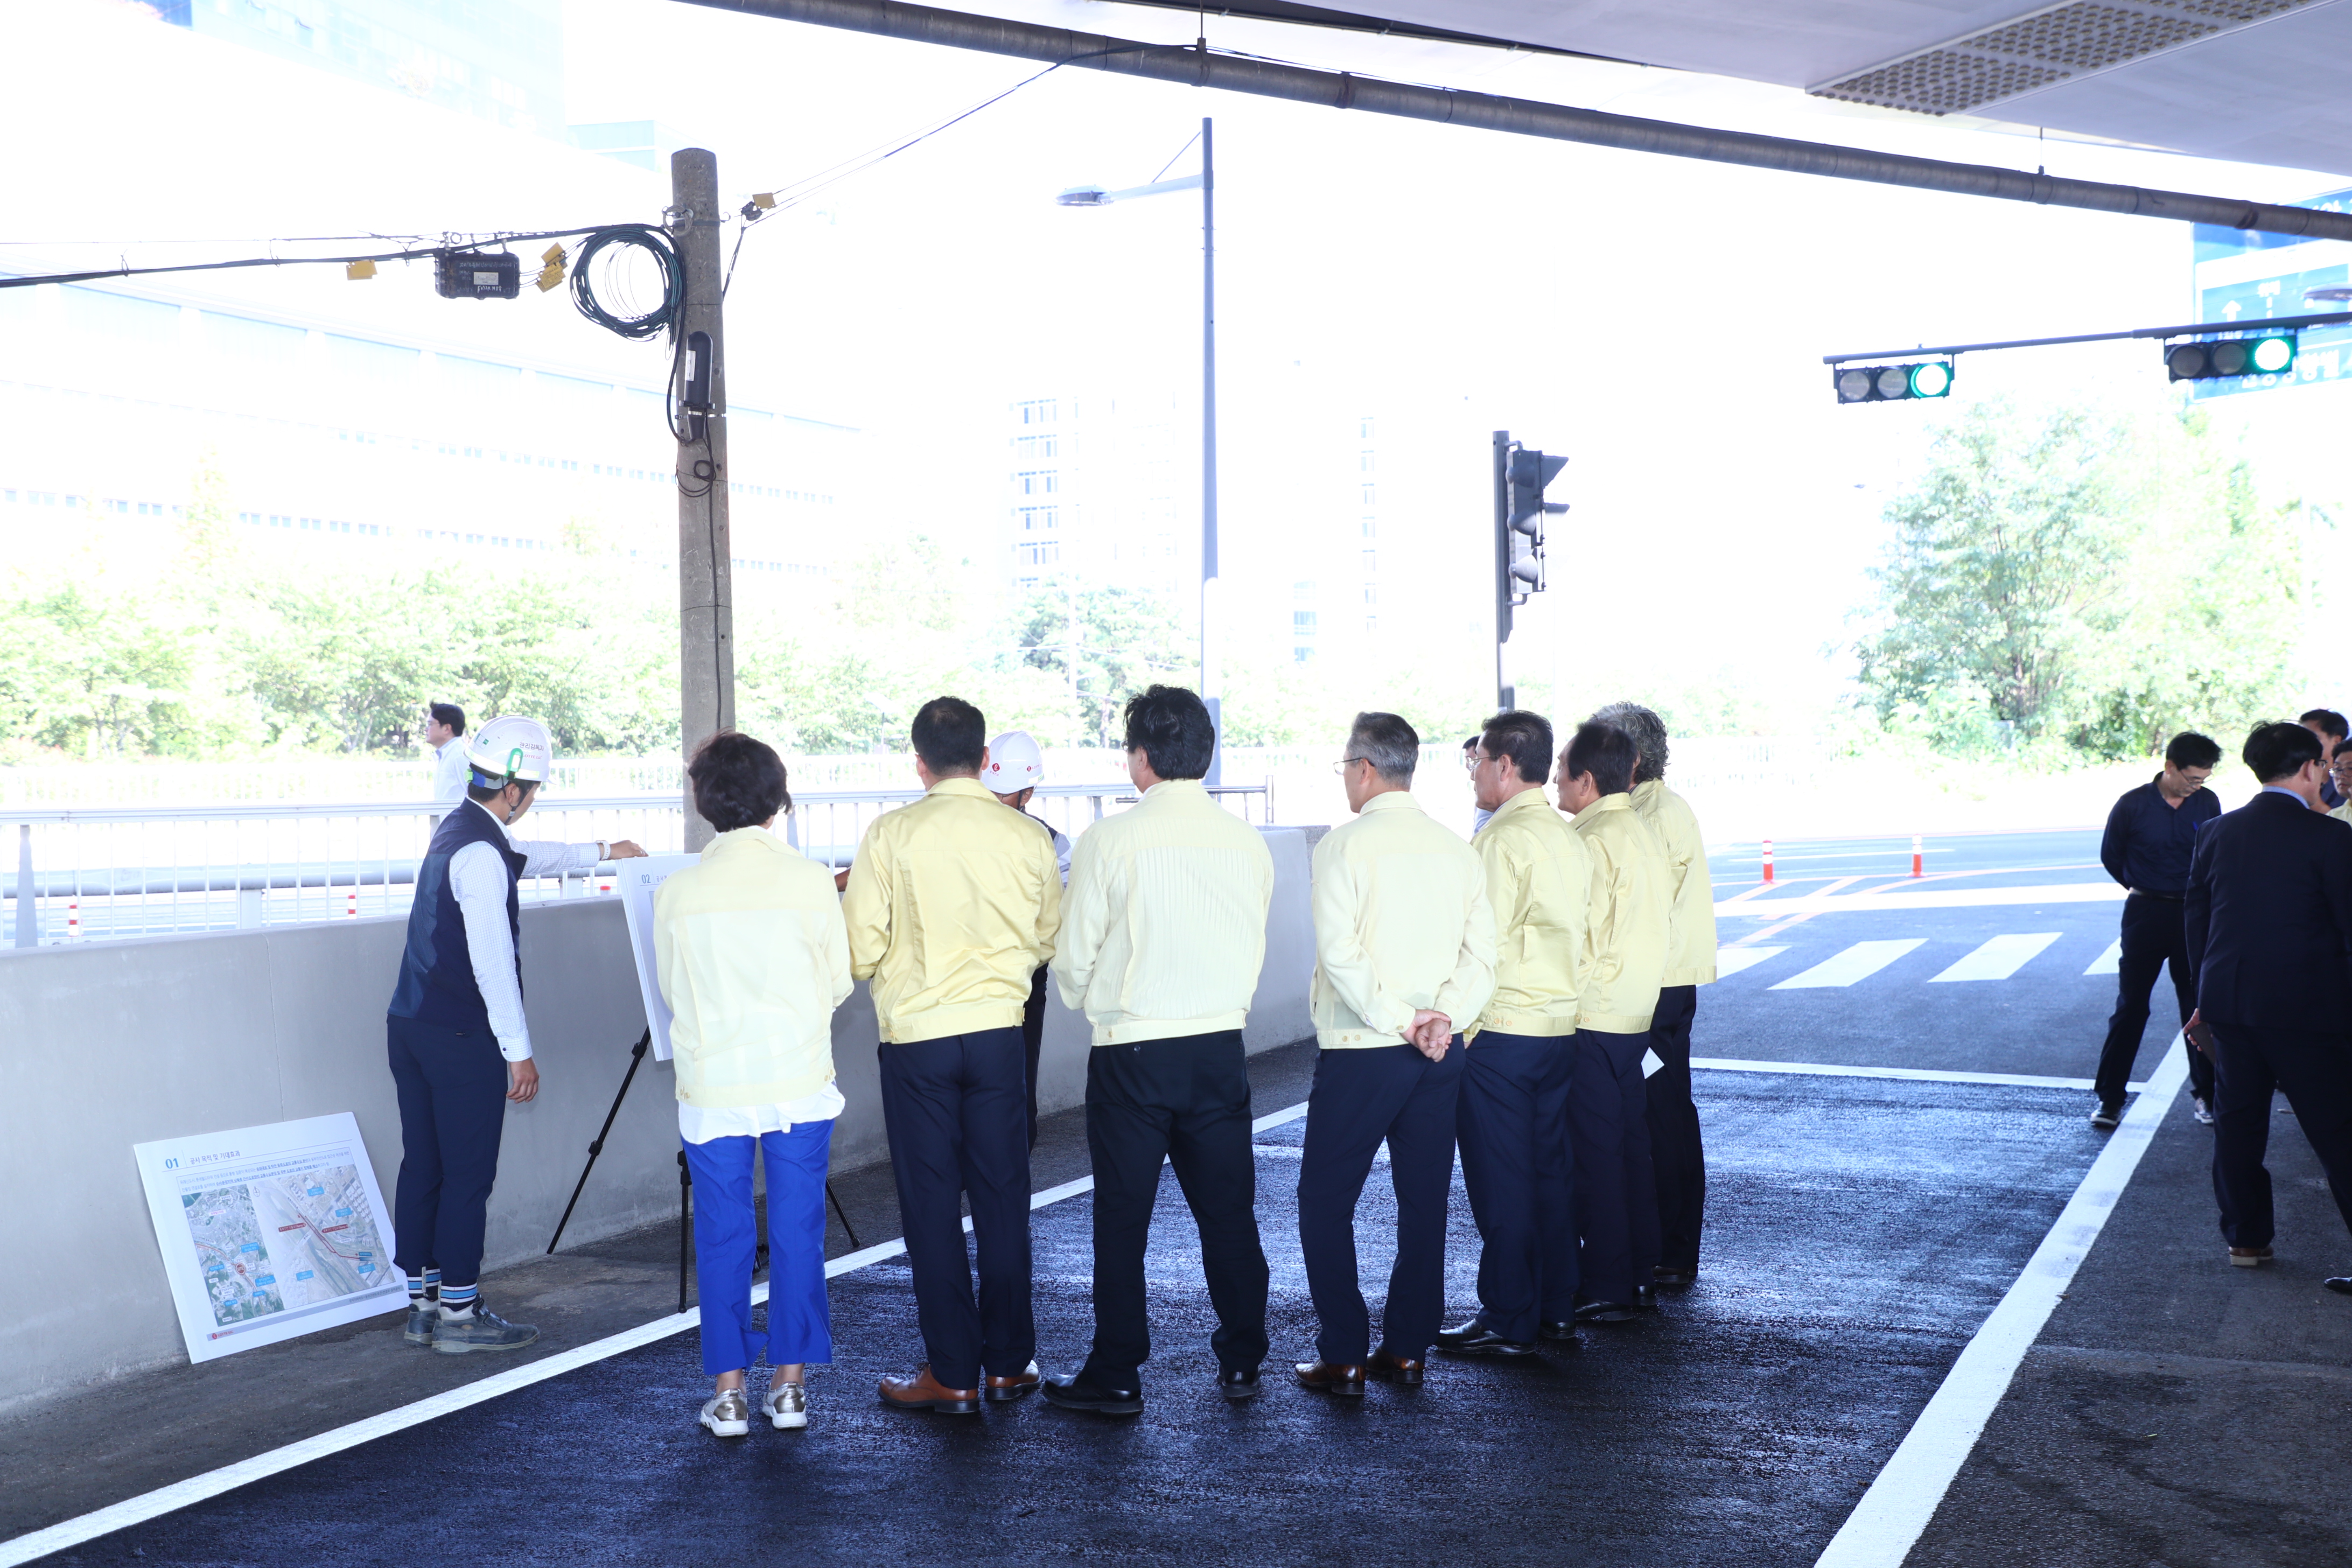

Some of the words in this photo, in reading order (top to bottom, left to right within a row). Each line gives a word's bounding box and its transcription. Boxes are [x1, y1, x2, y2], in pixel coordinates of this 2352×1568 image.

[520, 742, 544, 751] 관리감독자
[641, 874, 652, 884] 02
[190, 1157, 200, 1165] 공사
[202, 1154, 212, 1163] 목적
[220, 1150, 241, 1159] 기대효과
[165, 1158, 179, 1169] 01
